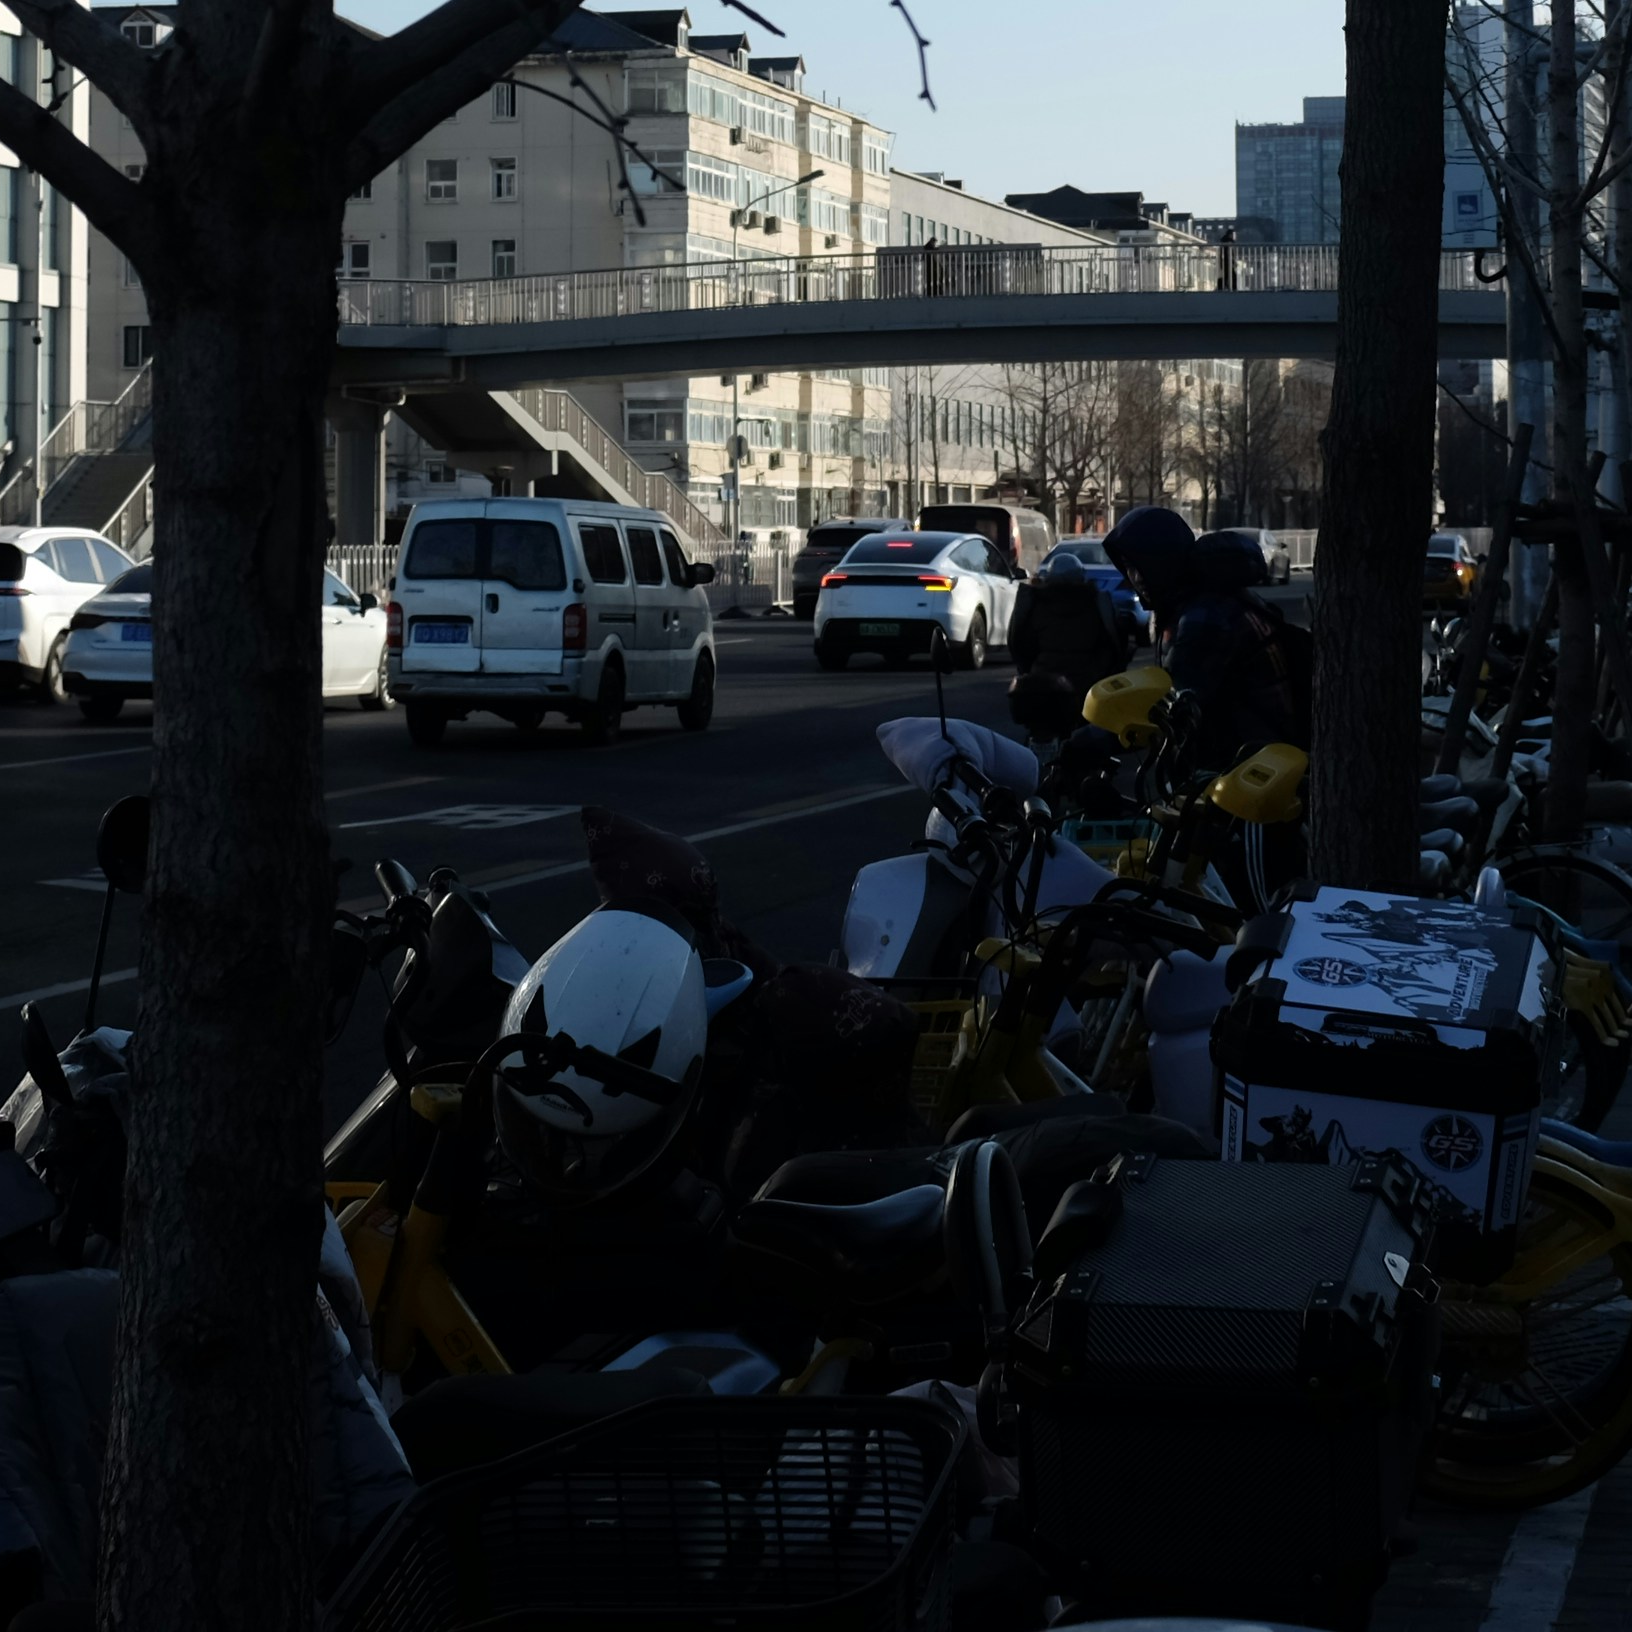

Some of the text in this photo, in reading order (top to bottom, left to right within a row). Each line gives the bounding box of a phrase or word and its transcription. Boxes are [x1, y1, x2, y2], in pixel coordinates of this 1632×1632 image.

[1321, 958, 1344, 984] GS
[1447, 957, 1473, 1018] ADVENTURE
[1428, 1134, 1478, 1152] GS
